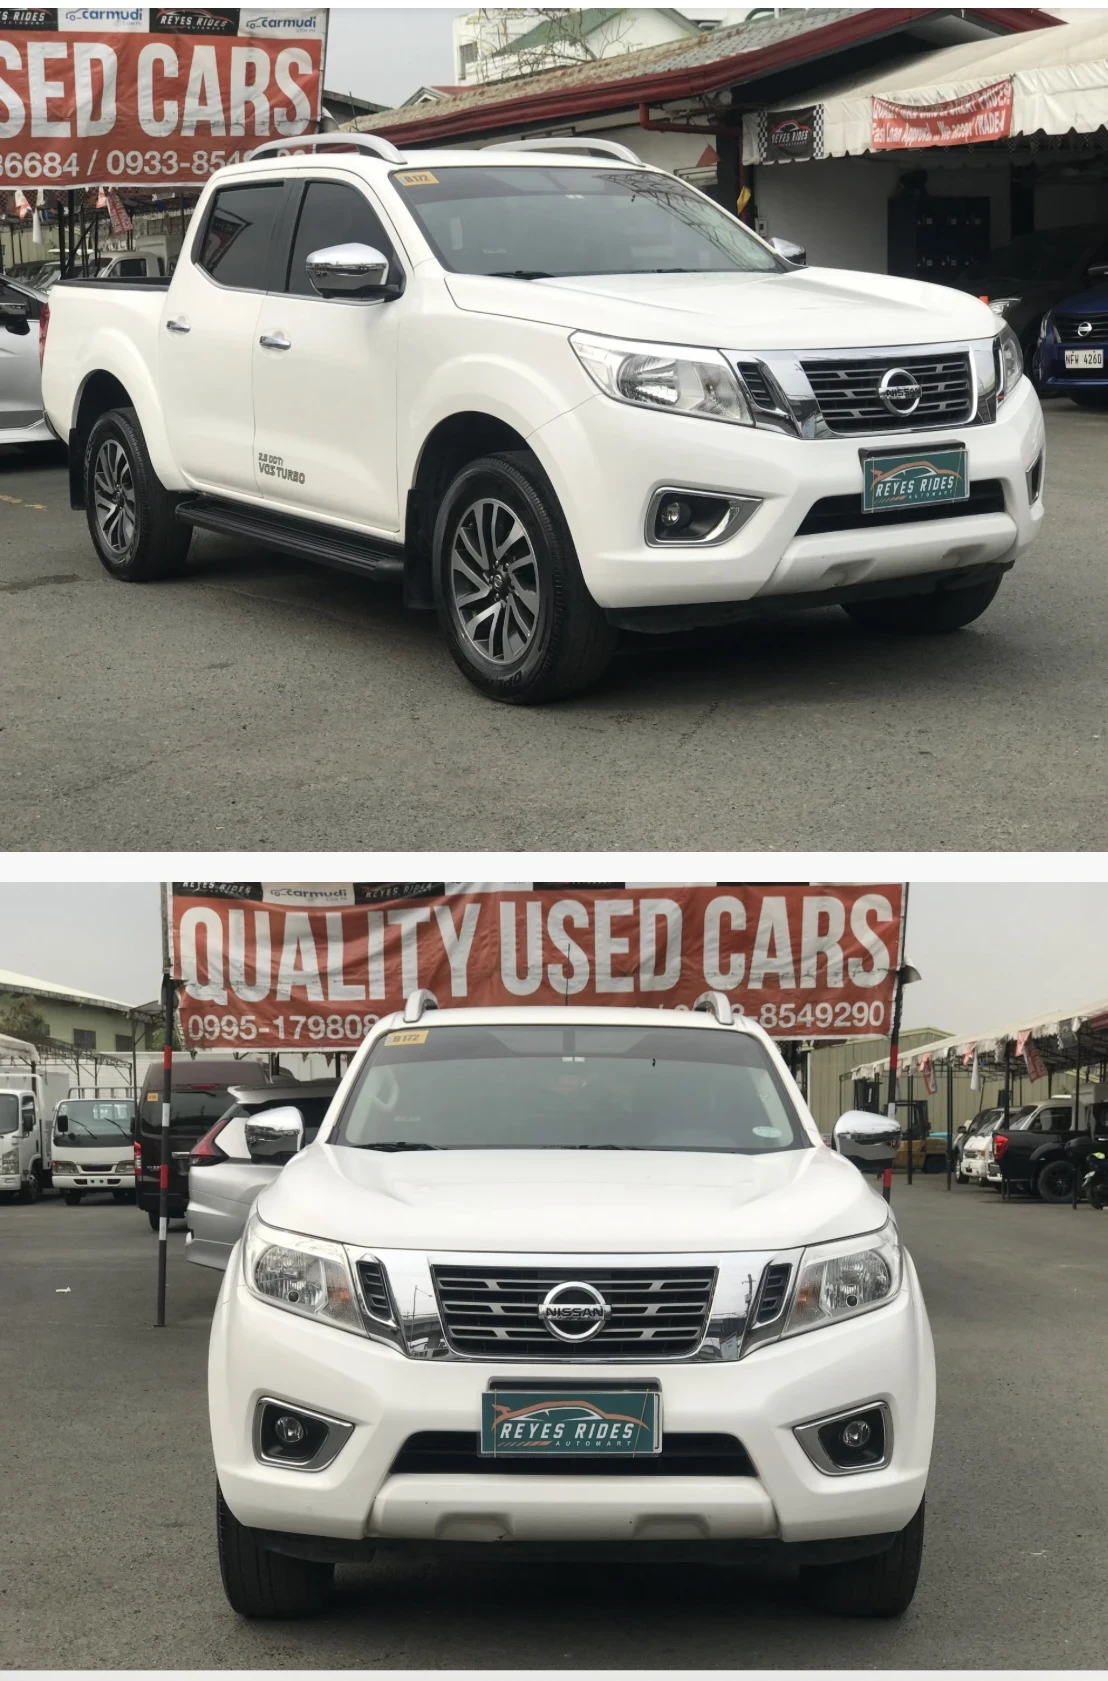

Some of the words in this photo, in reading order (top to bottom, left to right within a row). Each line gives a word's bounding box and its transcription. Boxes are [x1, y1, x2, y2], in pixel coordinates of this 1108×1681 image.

[14, 12, 46, 21] RIDES
[82, 8, 142, 20] carmudi
[160, 15, 193, 25] REYES
[196, 17, 228, 28] RIDES
[262, 16, 316, 28] carmudi
[138, 42, 313, 137] CARS
[771, 132, 790, 144] REYES
[87, 149, 99, 176] /
[886, 387, 920, 397] NISSAN
[276, 466, 305, 485] TURBO
[875, 480, 915, 498] REYES
[920, 475, 955, 492] RIDES
[908, 490, 954, 499] AUTOMART
[219, 883, 251, 894] RIDES
[286, 888, 347, 898] carmudi
[180, 903, 481, 1006] QUALITY
[500, 899, 683, 996] USED
[703, 893, 893, 990] CARS
[546, 1307, 604, 1317] NISSAN
[500, 1423, 565, 1439] REYES
[575, 1423, 635, 1439] RIDES
